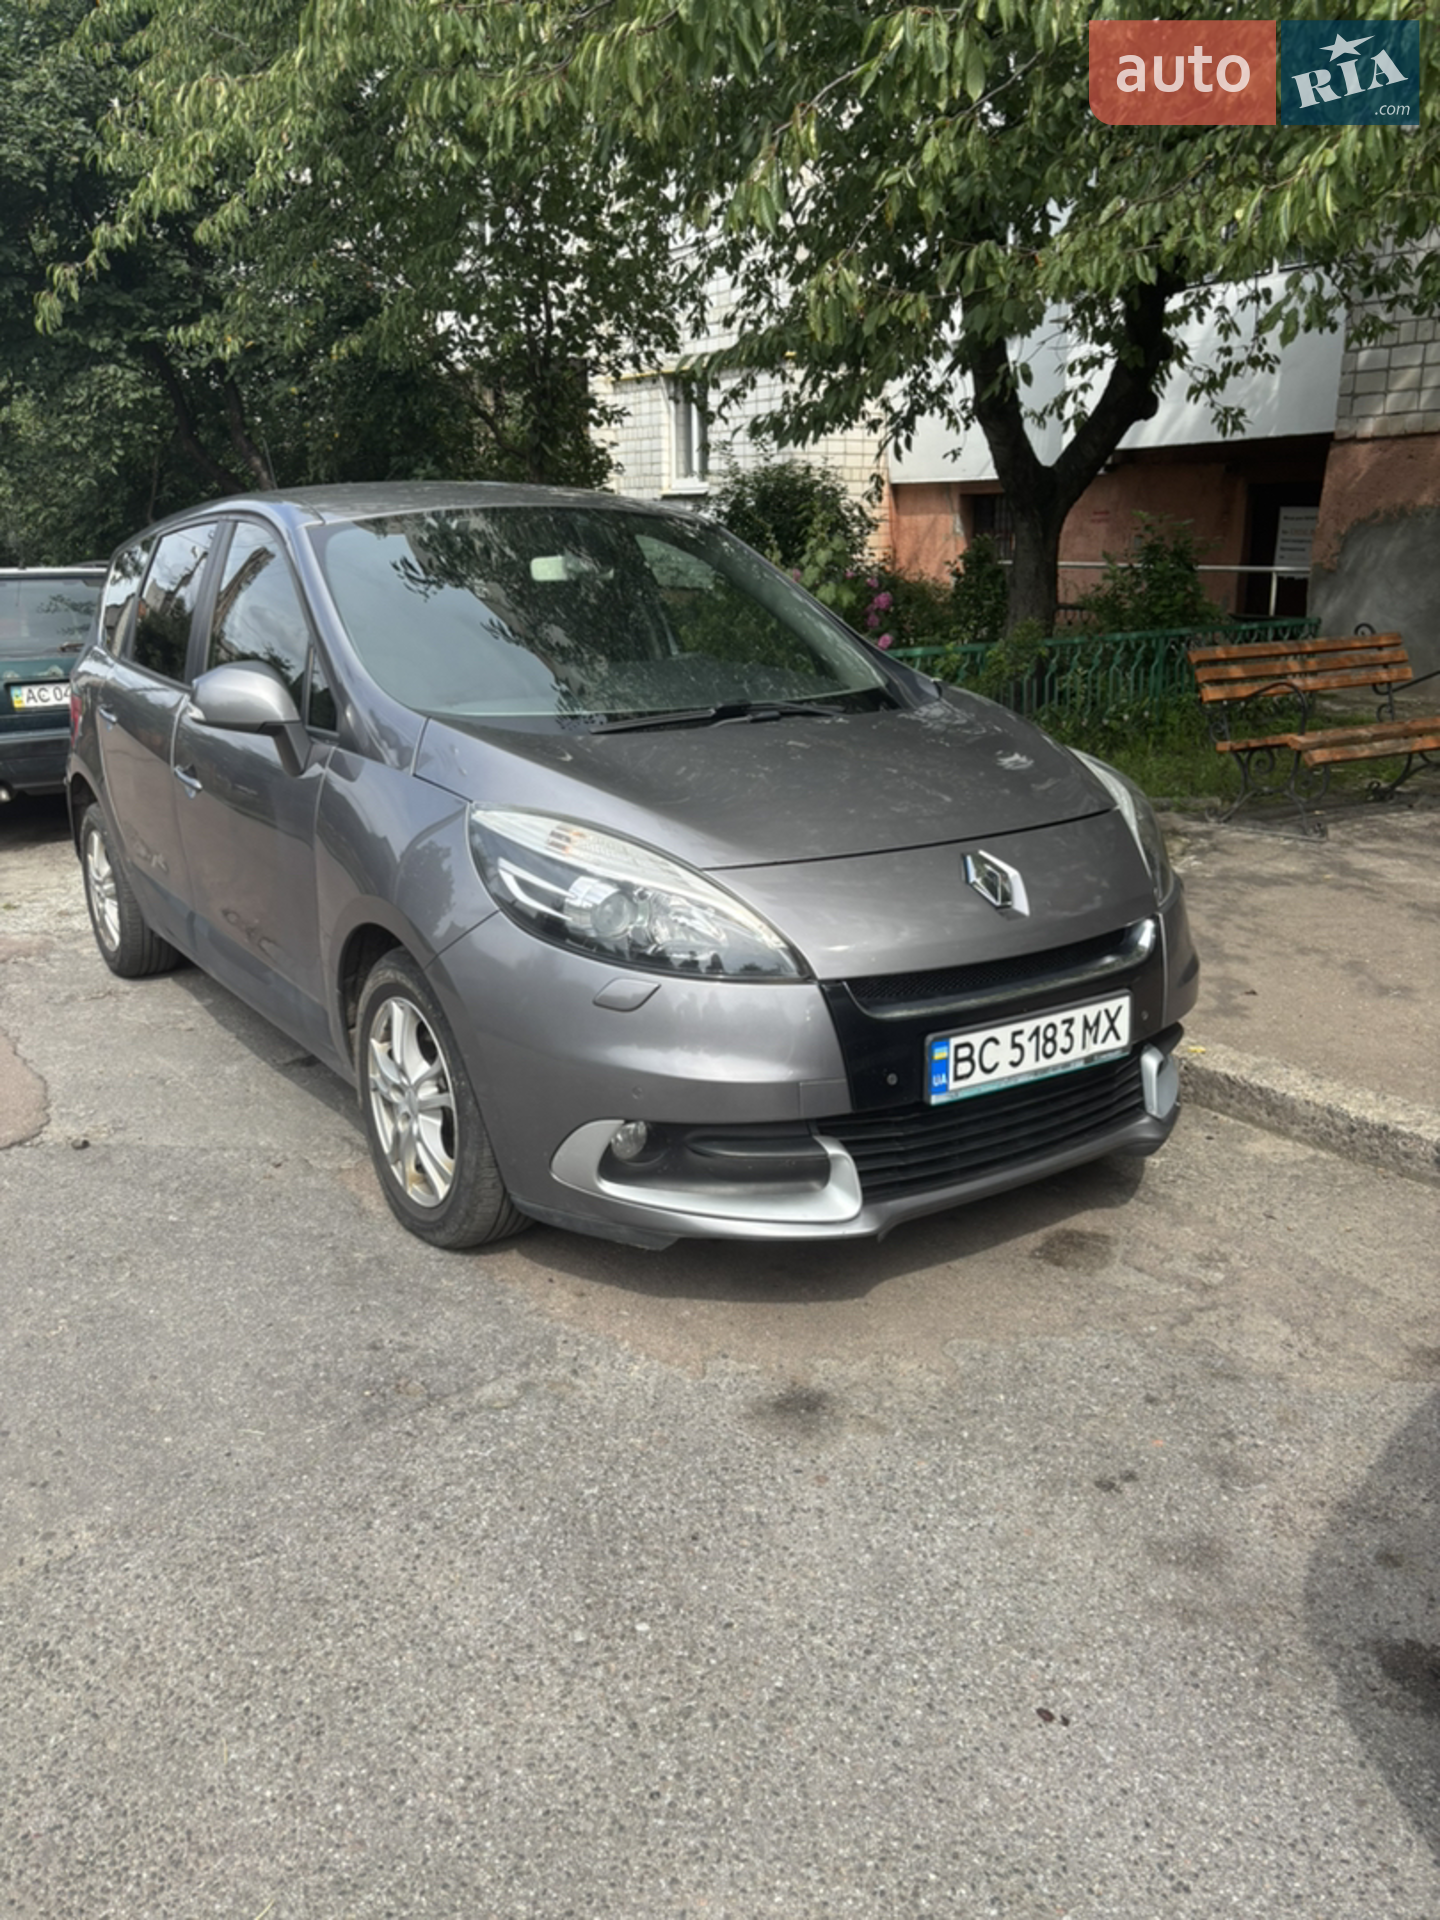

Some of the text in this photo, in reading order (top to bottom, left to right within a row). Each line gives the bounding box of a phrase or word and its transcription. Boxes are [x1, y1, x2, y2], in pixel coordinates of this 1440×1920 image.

[26, 687, 51, 703] AC
[952, 1036, 1001, 1082] BC
[1008, 1017, 1075, 1068] 5183
[1081, 1004, 1123, 1050] MX
[931, 1073, 948, 1087] UA
